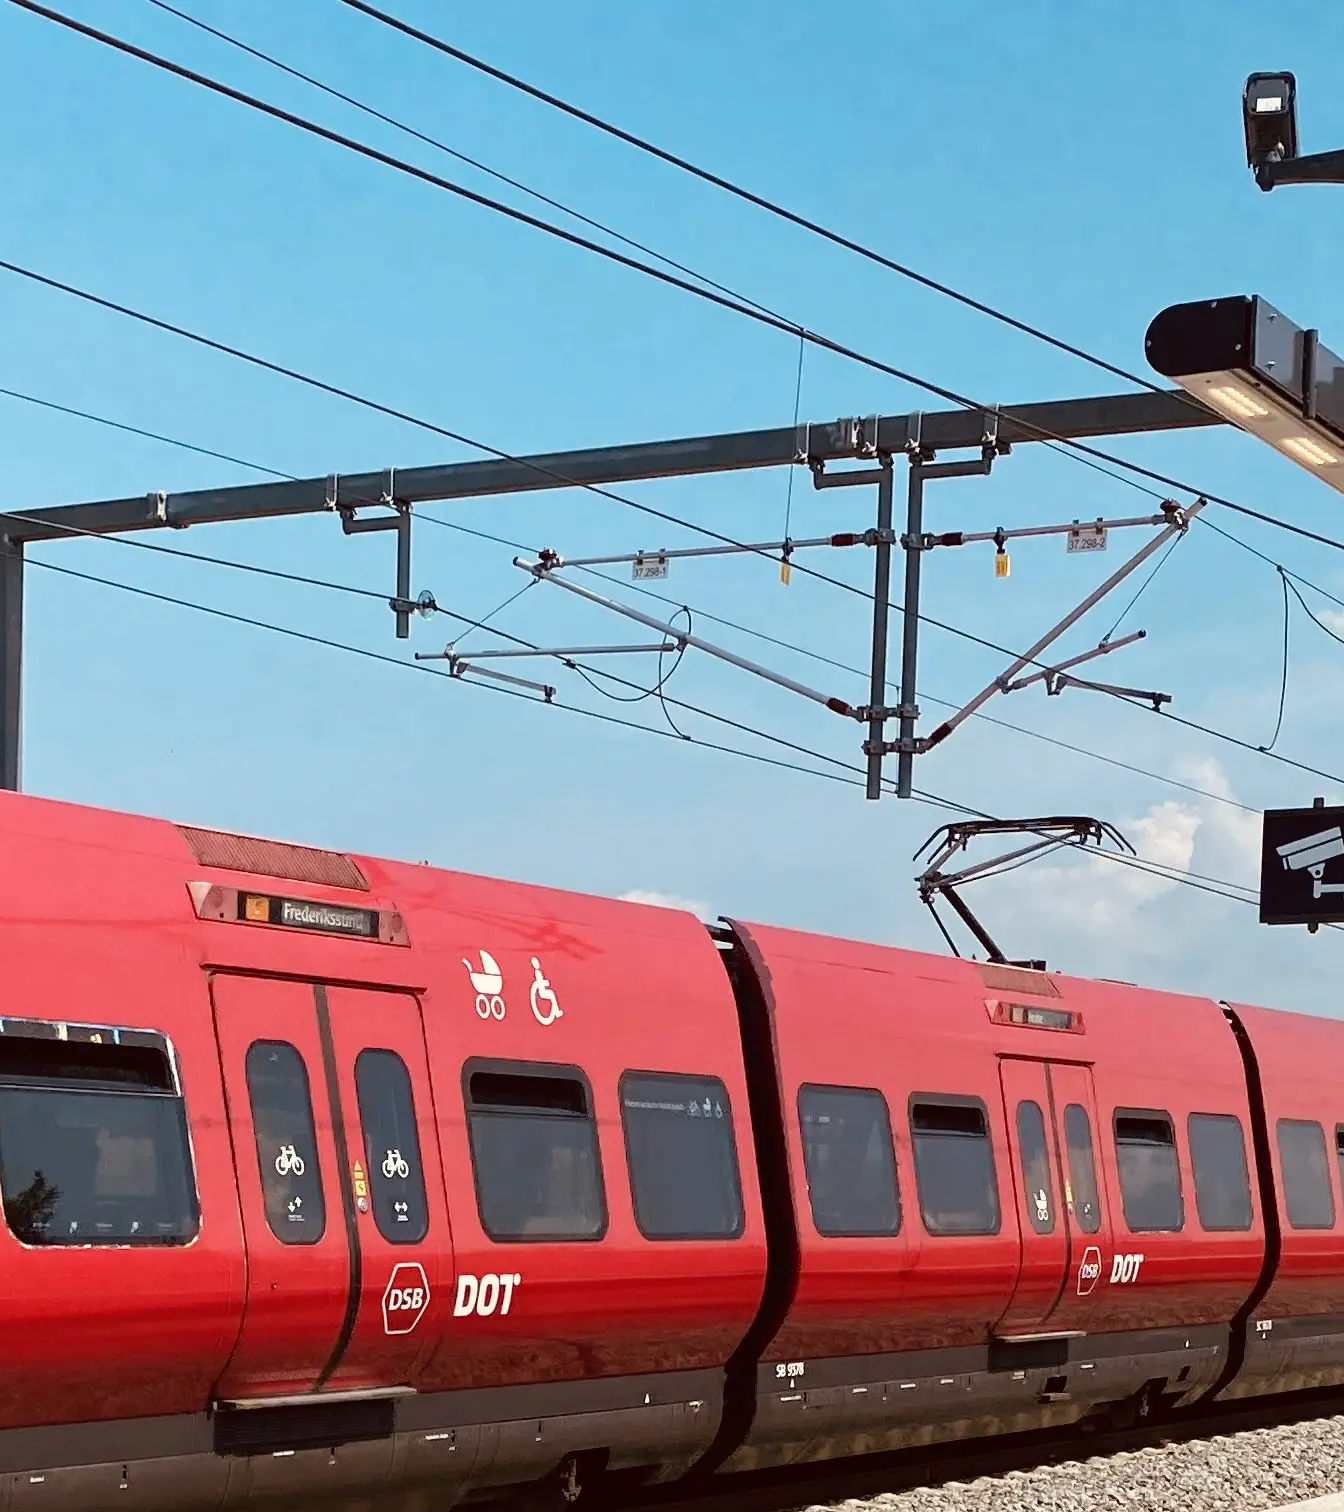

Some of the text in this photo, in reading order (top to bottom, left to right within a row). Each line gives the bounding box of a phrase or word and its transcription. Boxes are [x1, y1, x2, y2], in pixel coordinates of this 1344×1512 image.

[284, 902, 364, 930] Frederikssund
[1110, 1254, 1144, 1283] DOT
[389, 1273, 521, 1316] DSB DOT
